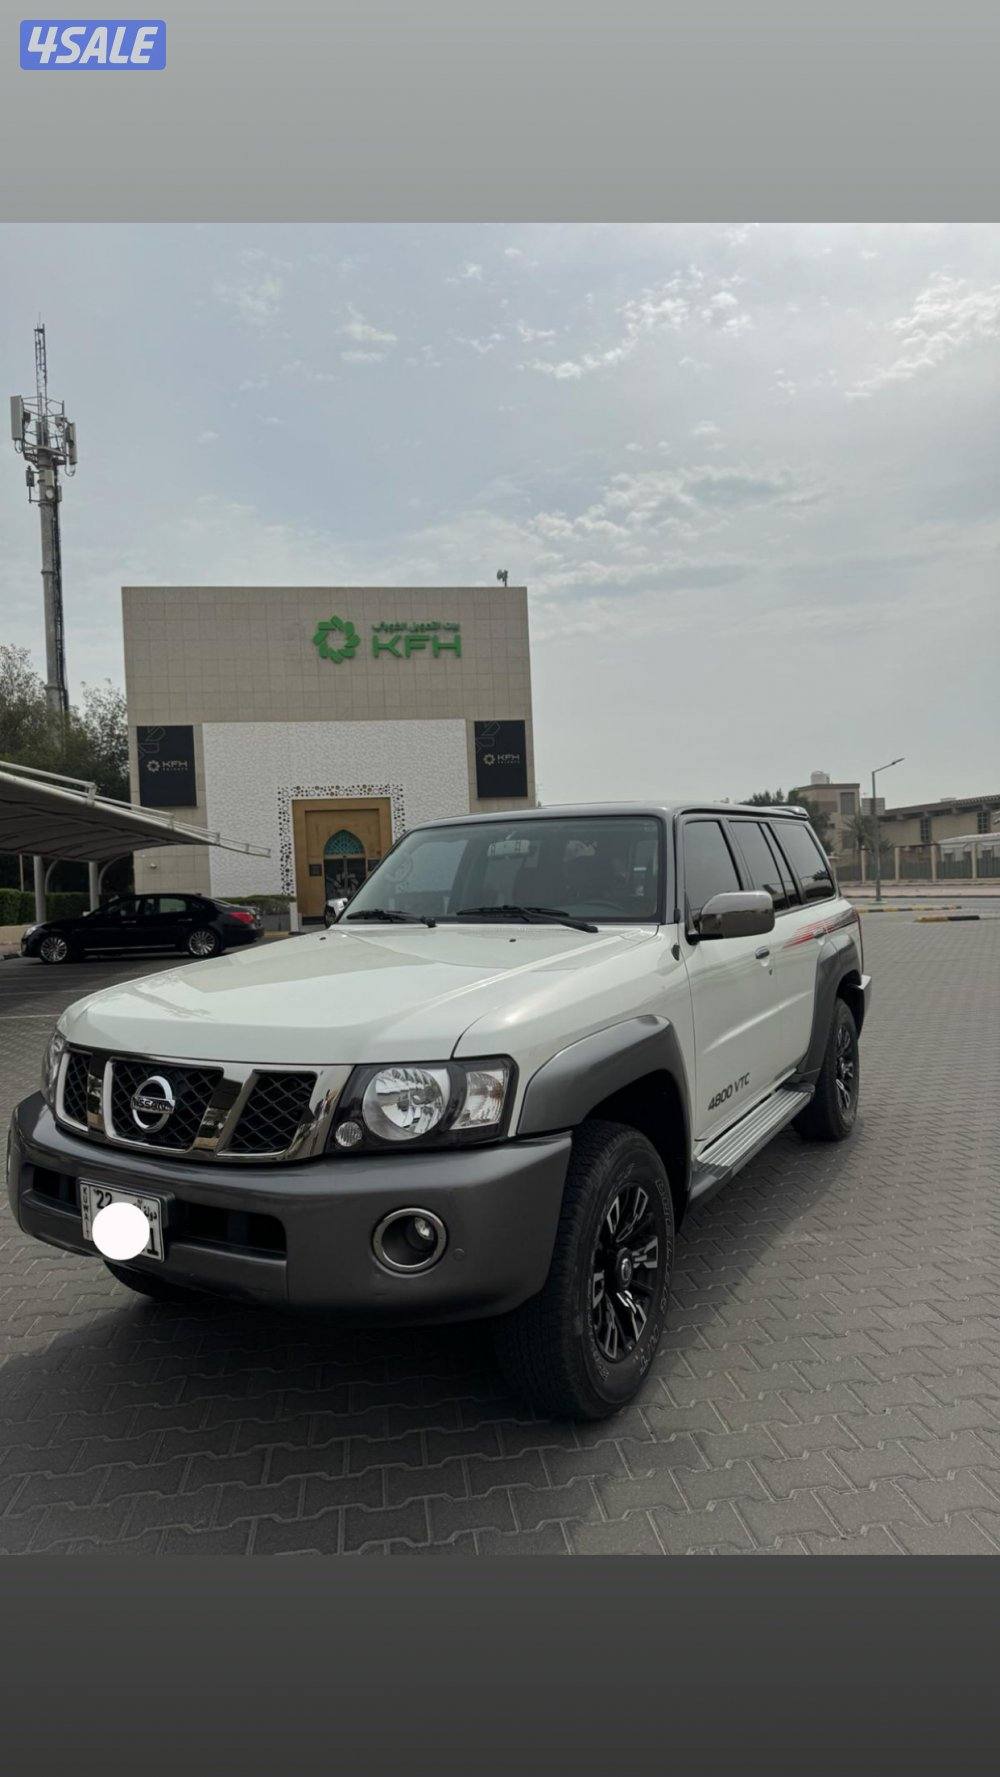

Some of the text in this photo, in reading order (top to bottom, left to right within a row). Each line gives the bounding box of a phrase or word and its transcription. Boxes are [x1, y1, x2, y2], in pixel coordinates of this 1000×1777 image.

[372, 634, 462, 659] KFH
[162, 760, 188, 768] KFH
[708, 1072, 750, 1111] 4800 VTC
